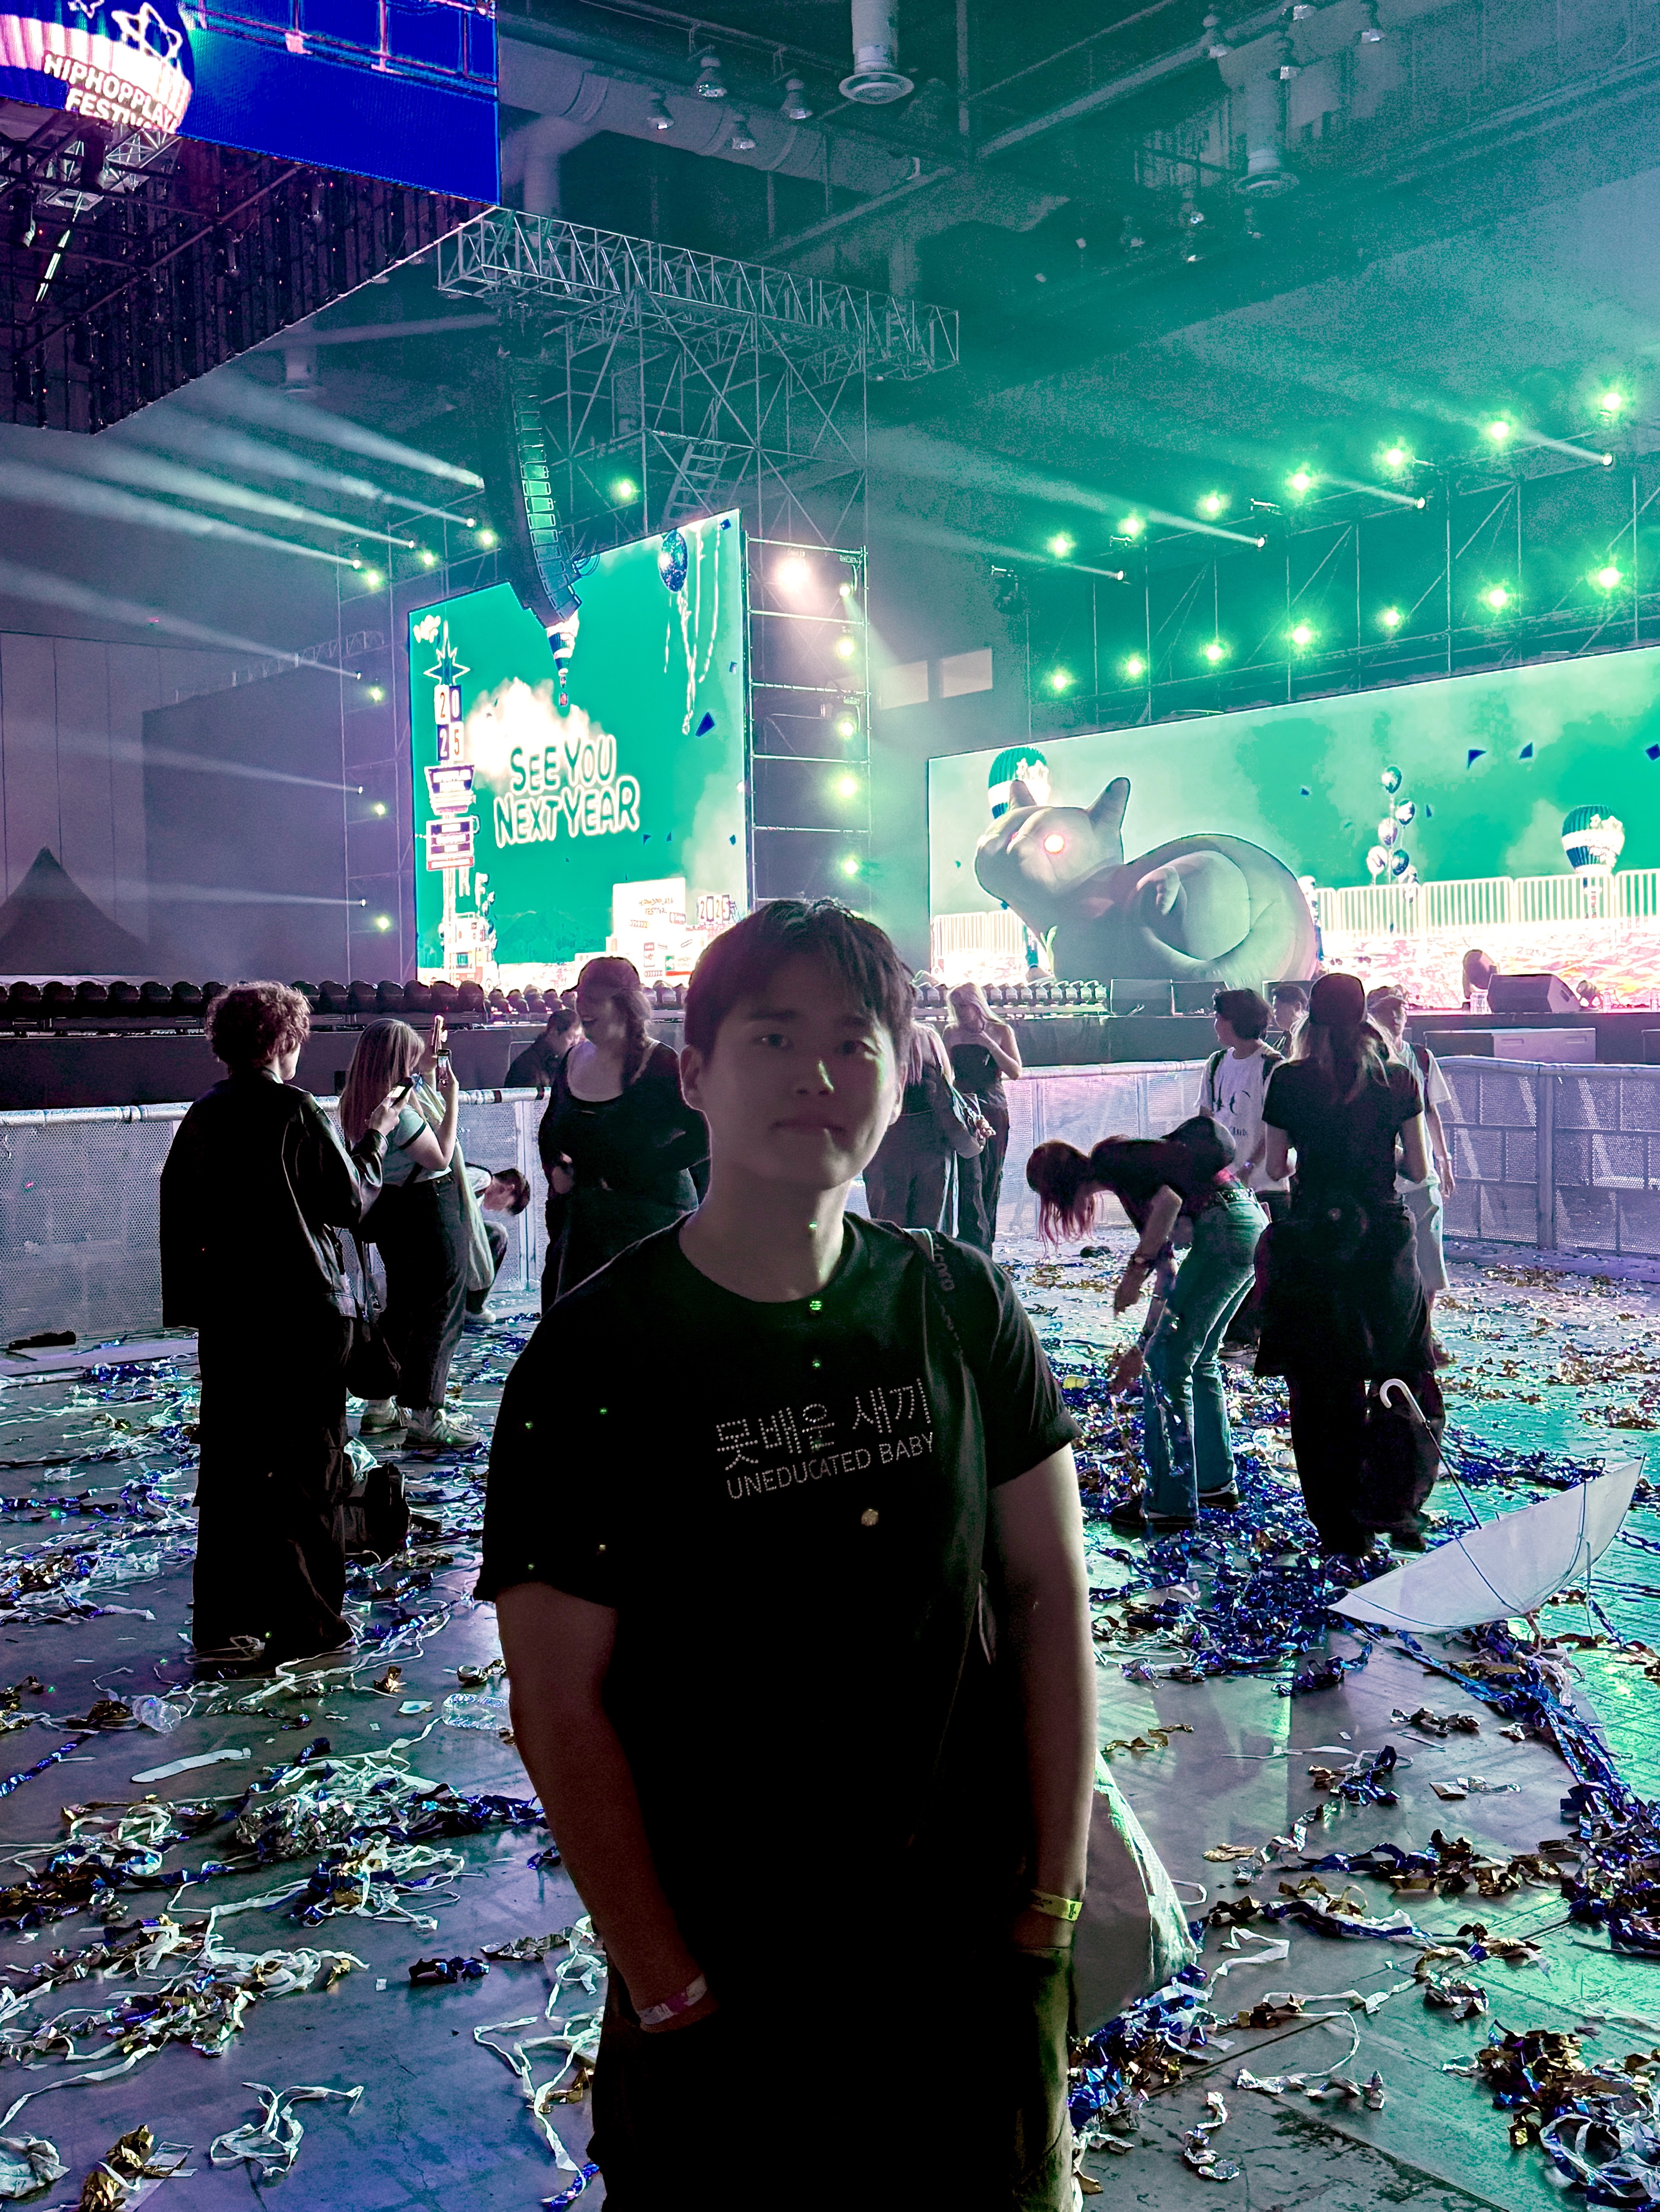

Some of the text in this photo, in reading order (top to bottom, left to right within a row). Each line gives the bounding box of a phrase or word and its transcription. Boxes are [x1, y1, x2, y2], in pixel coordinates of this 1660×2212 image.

[510, 734, 617, 796] SEE YOU
[494, 775, 640, 848] NEXT YEAR
[716, 1378, 931, 1471] 못배운 새끼
[726, 1431, 933, 1499] UNEDUCATED BABY
